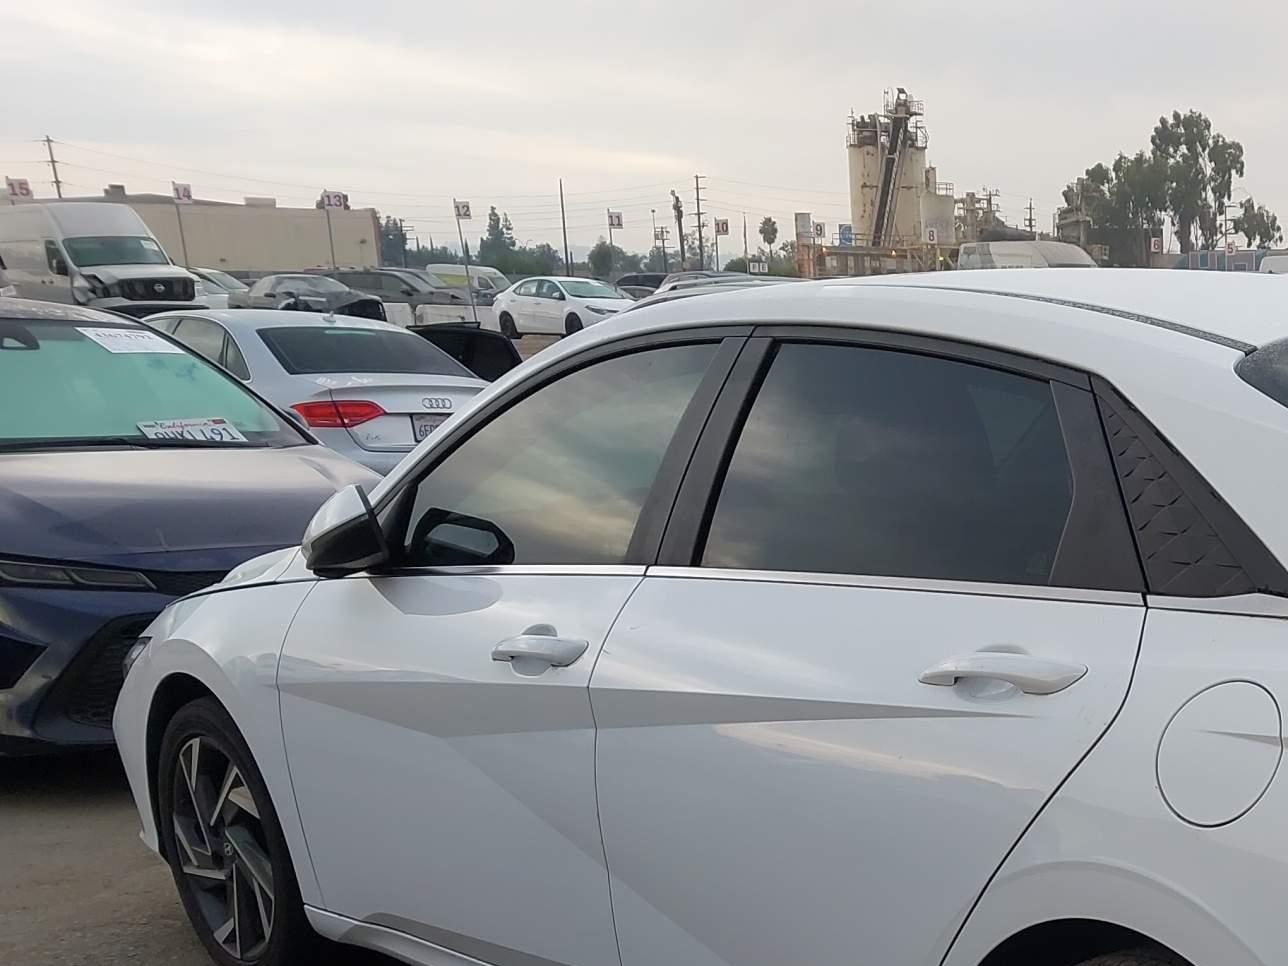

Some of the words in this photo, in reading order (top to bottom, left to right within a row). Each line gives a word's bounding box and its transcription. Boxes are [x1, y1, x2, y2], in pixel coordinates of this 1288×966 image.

[8, 182, 30, 197] 15
[174, 187, 192, 200] 14
[325, 194, 343, 207] 13
[455, 204, 471, 217] 12
[608, 214, 623, 227] 11
[715, 221, 729, 234] 10
[815, 223, 823, 236] 9
[928, 230, 935, 242] 8
[1153, 239, 1160, 251] 6
[1227, 243, 1235, 254] 5
